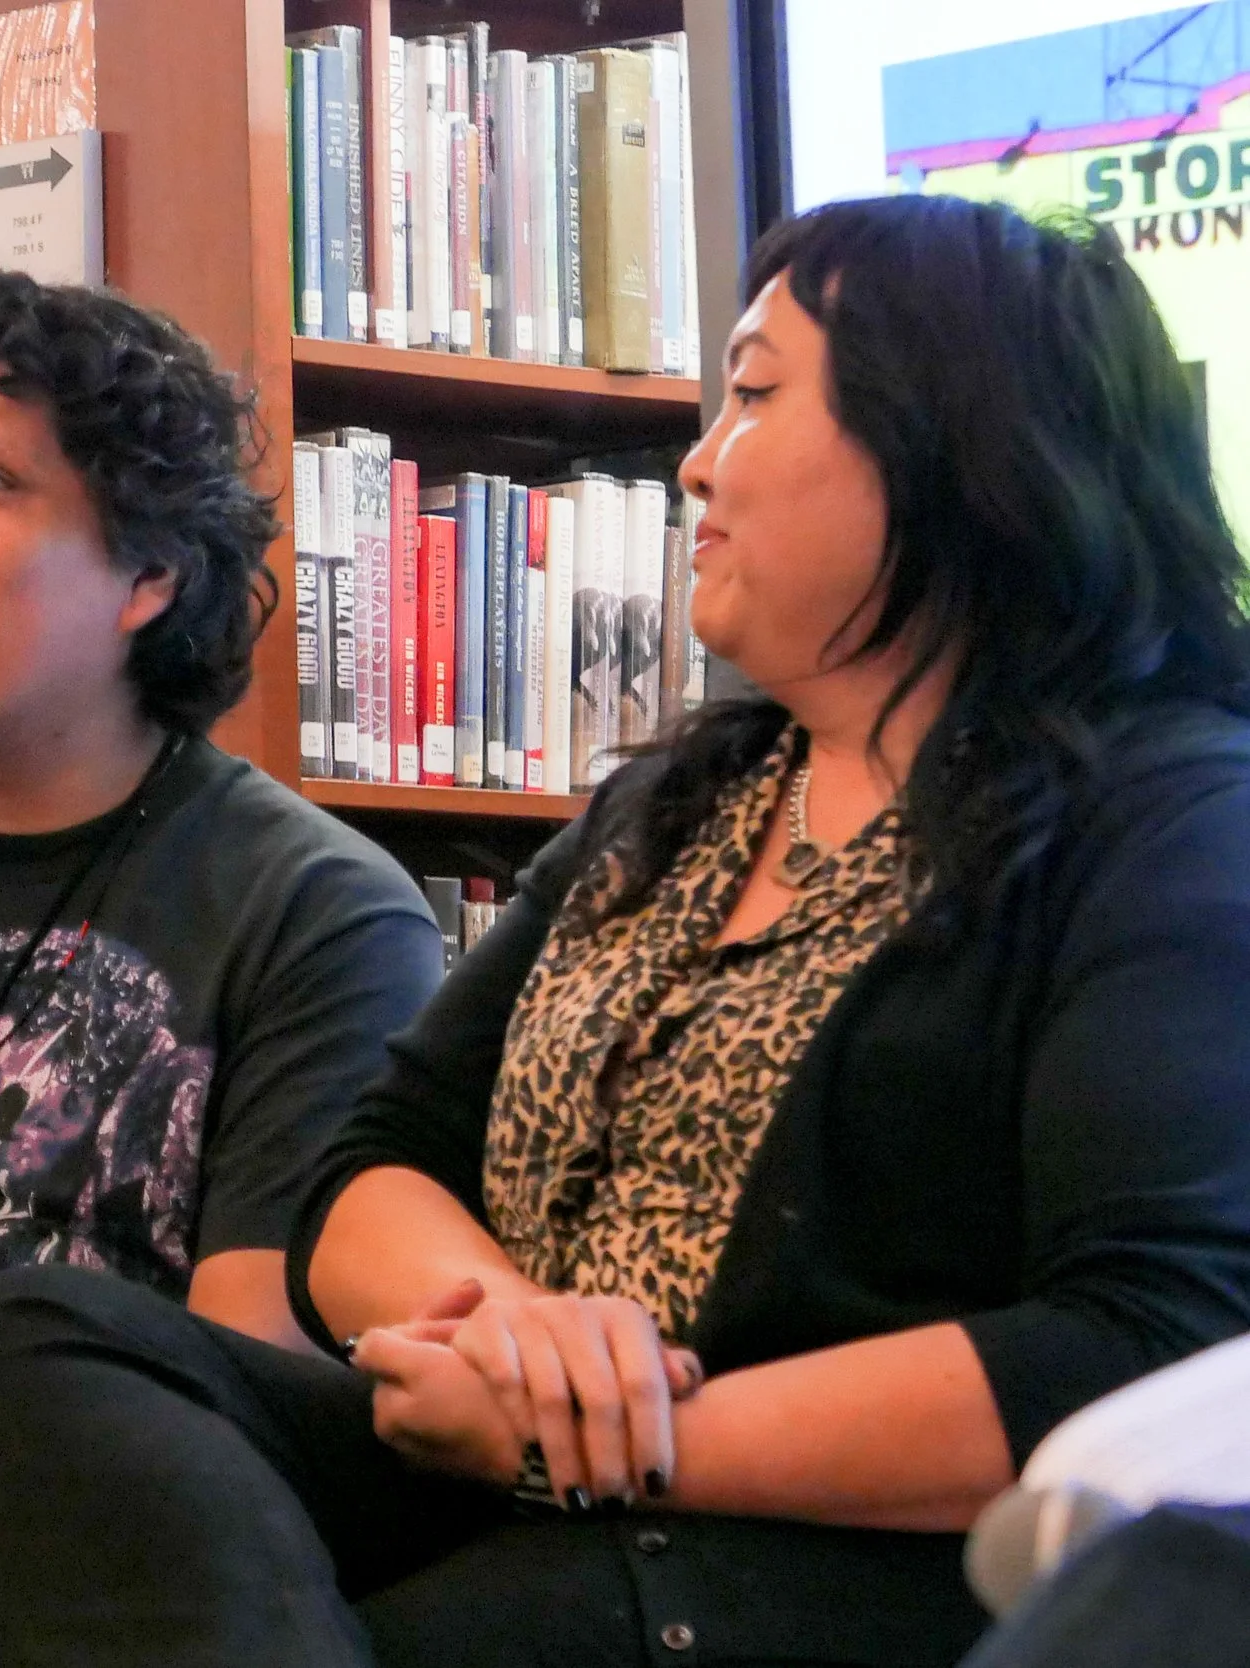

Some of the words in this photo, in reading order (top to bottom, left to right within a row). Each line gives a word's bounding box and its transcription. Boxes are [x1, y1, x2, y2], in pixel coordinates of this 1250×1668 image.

[390, 49, 405, 133] FUNNY
[569, 103, 577, 147] HELM
[348, 102, 361, 214] FINISHED
[569, 163, 578, 177] A
[456, 150, 468, 236] CITATION
[569, 186, 579, 245] BREED
[571, 251, 581, 309] APART
[296, 560, 317, 629] CRAZY
[335, 565, 356, 633] CRAZY
[354, 536, 371, 684] GREATEST
[371, 540, 388, 684] GREATEST
[435, 543, 446, 630] LEXINGTON
[494, 510, 507, 669] HORSEPLAYERS
[296, 632, 318, 686] GOOD
[336, 637, 355, 690] GOOD
